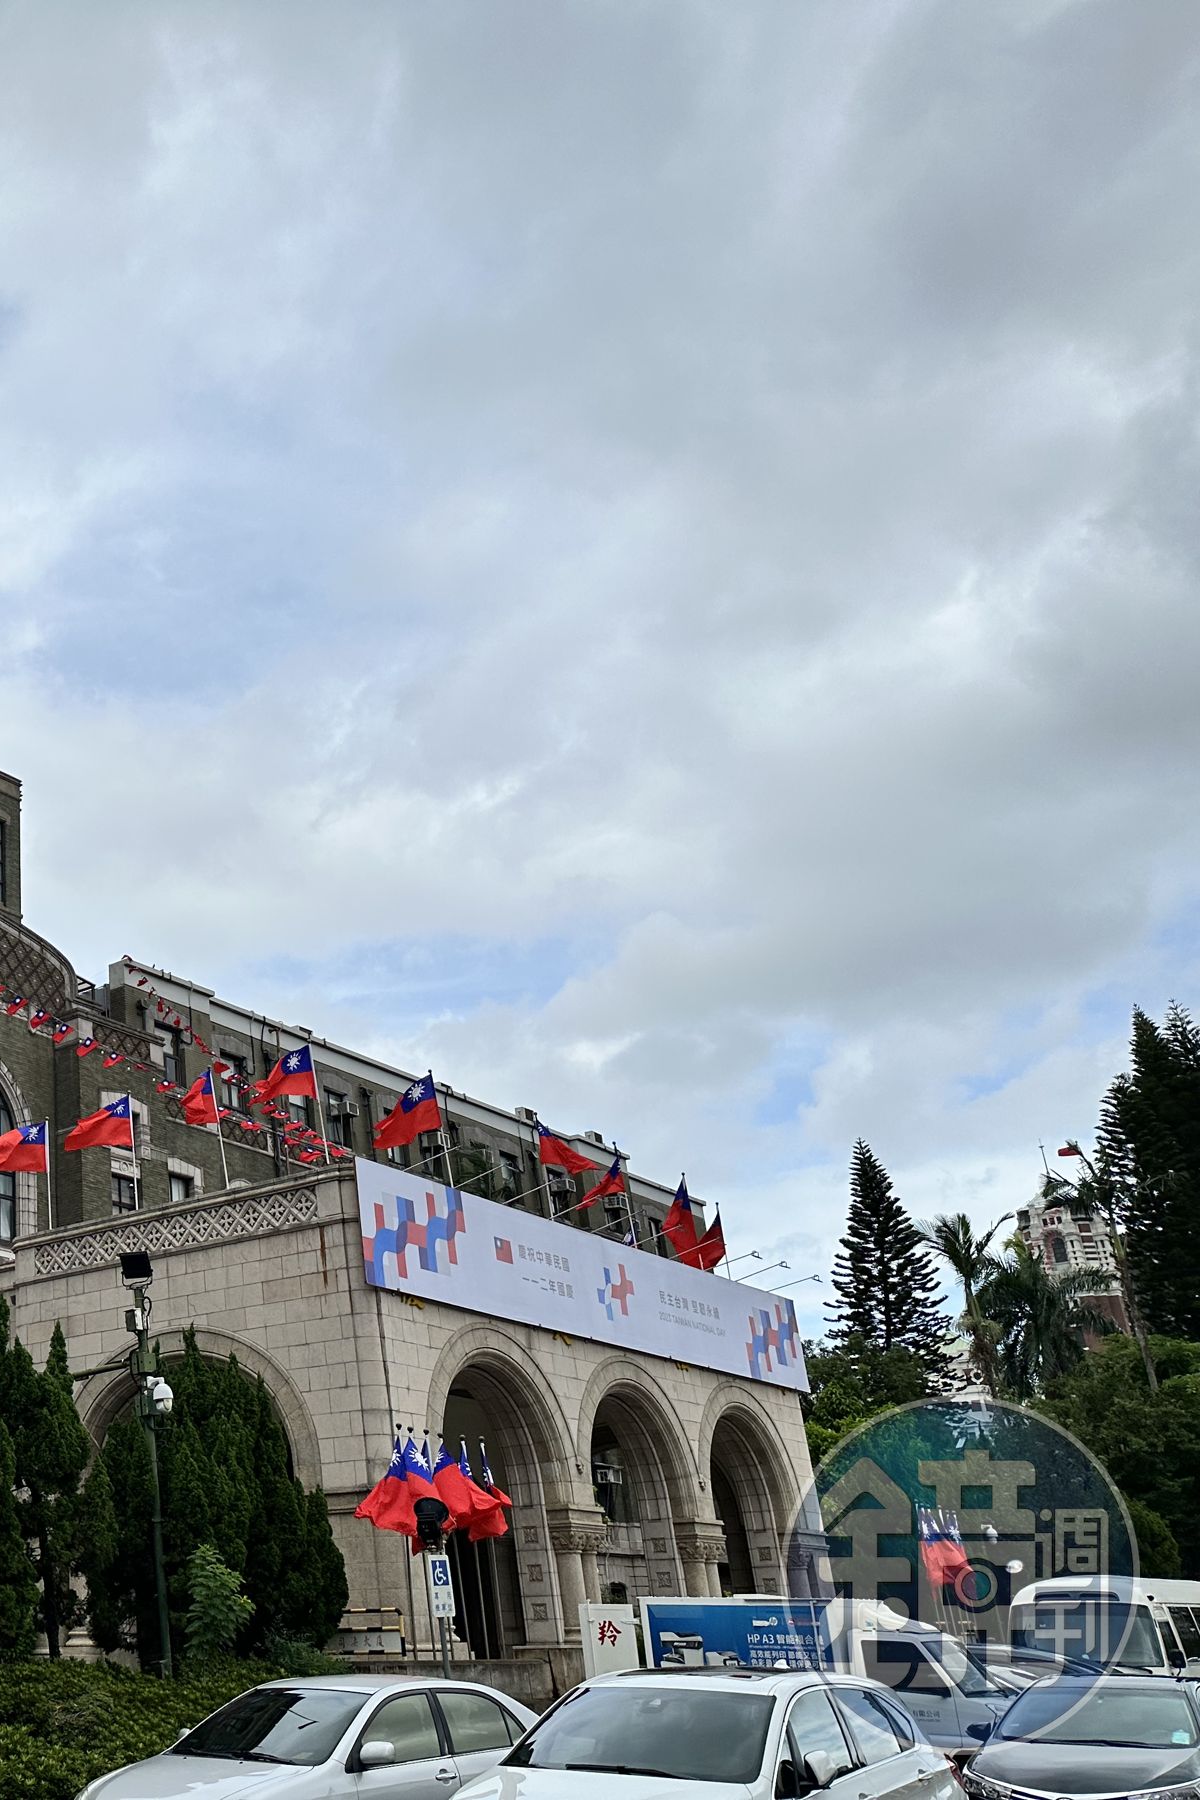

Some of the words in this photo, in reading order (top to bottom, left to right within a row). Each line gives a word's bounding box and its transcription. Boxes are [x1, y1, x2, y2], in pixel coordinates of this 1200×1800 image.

[518, 1244, 571, 1272] 慶祝中華民國
[522, 1277, 575, 1300] 一一二年國慶
[659, 1290, 689, 1311] 民主台灣
[658, 1311, 672, 1323] 2023
[672, 1315, 692, 1328] TAIWAN
[691, 1320, 716, 1336] NATIONAL
[717, 1327, 727, 1337] DAY
[597, 1620, 622, 1647] 羚
[747, 1634, 760, 1644] HP
[762, 1634, 775, 1644] A3
[912, 1709, 941, 1718] 有限公司
